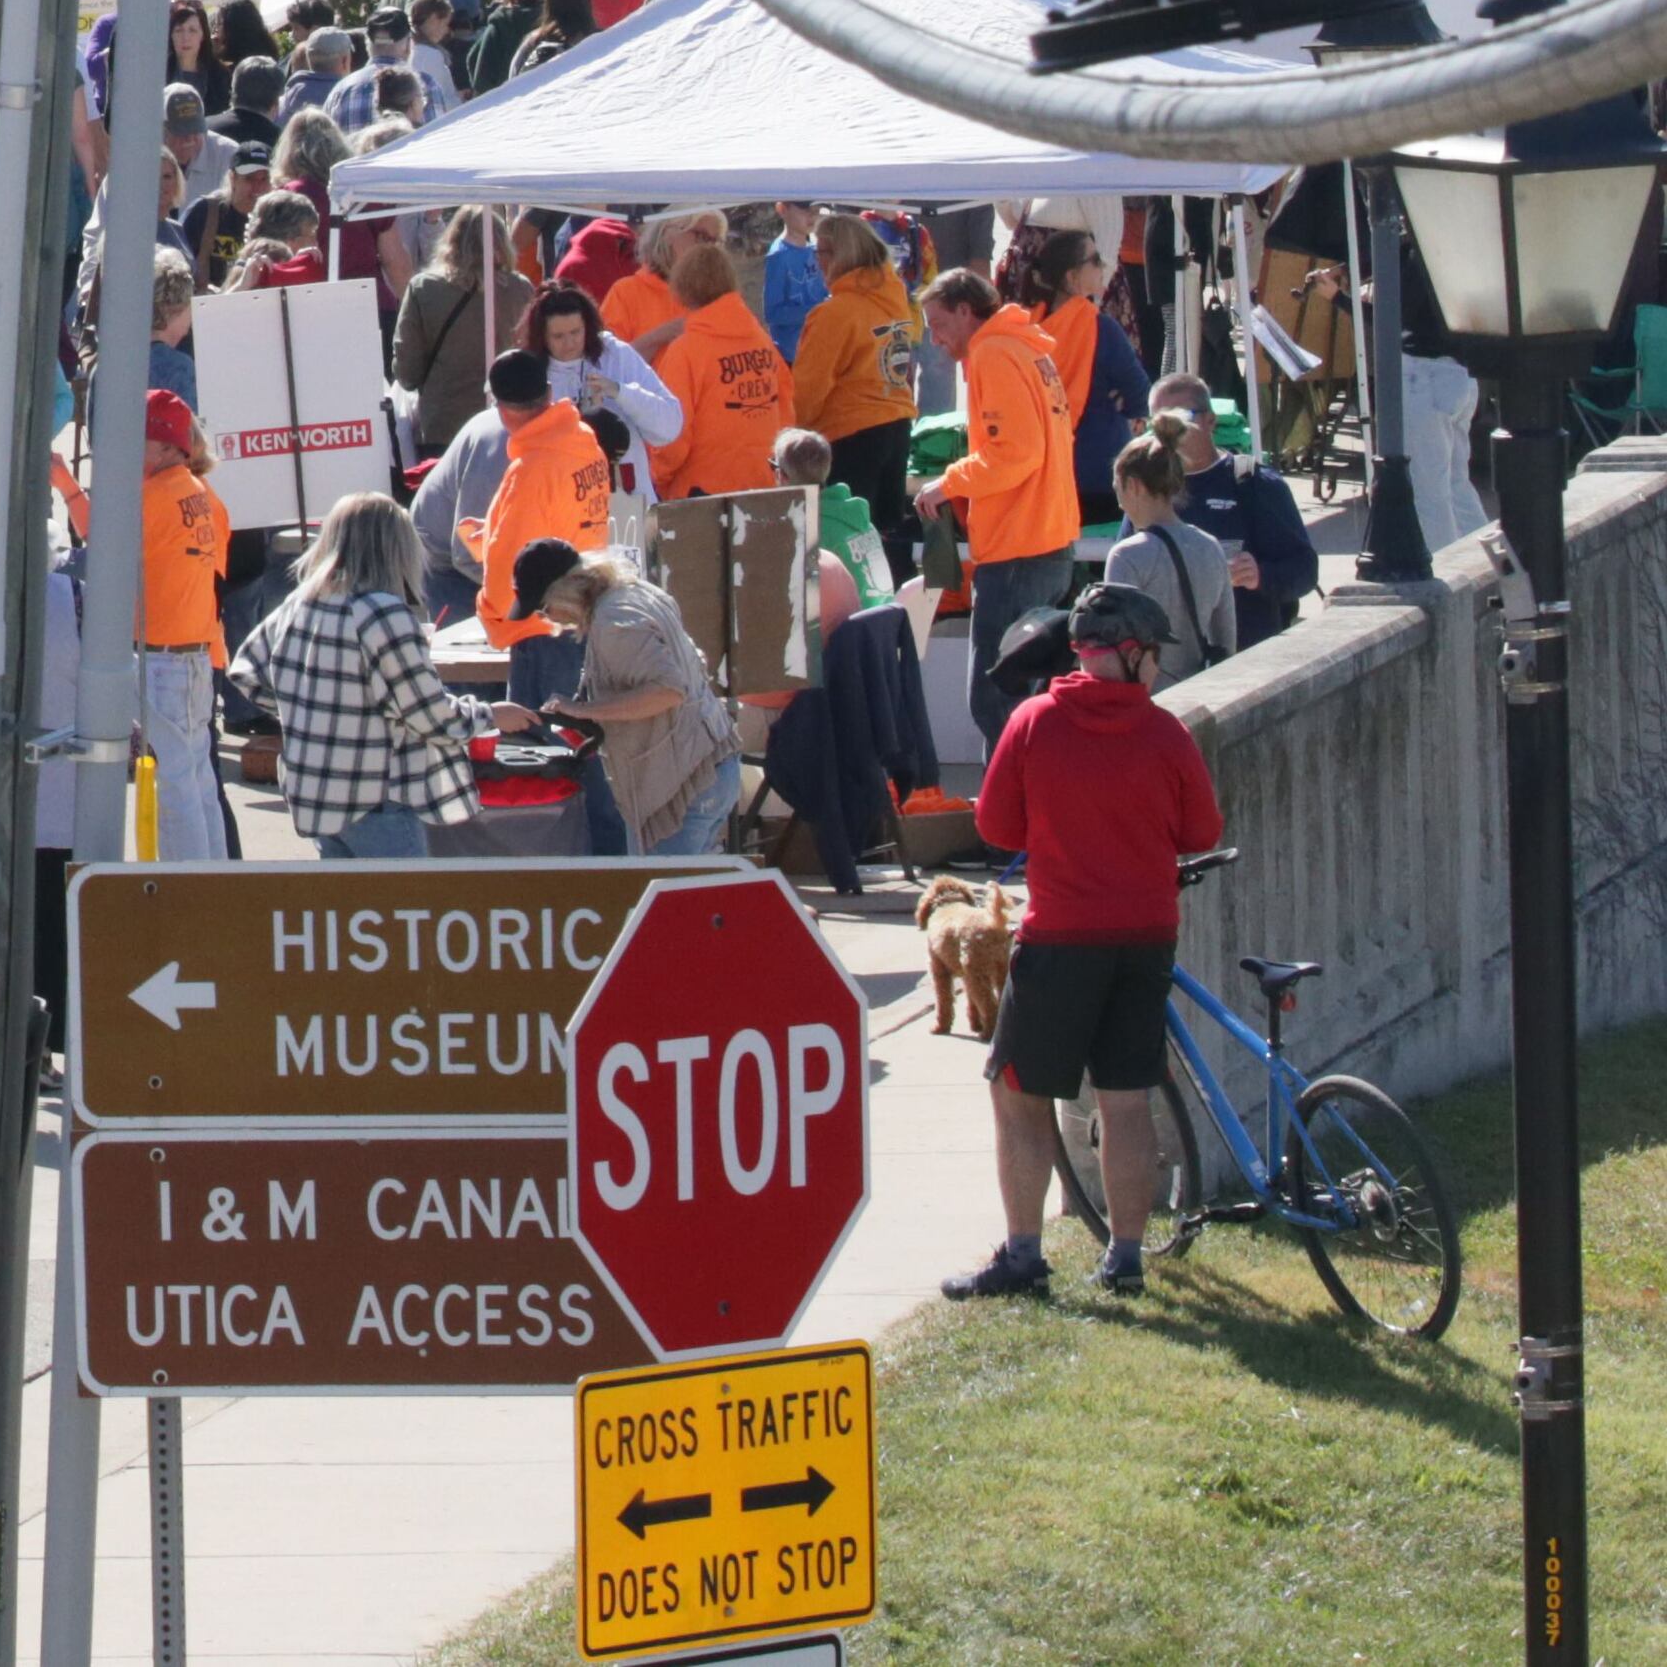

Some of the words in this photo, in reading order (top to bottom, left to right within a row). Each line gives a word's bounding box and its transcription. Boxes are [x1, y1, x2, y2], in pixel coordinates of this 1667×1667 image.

[718, 347, 777, 385] BURGO
[272, 908, 633, 973] HISTORIC
[593, 1022, 845, 1212] STOP
[159, 1180, 172, 1242] I
[201, 1187, 247, 1242] &
[269, 1179, 318, 1241] M
[125, 1285, 307, 1347] UTICA
[347, 1283, 595, 1347] ACCESS
[593, 1407, 699, 1470] CROSS
[717, 1385, 854, 1454] TRAFFIC
[597, 1563, 681, 1623] DOES
[699, 1550, 760, 1606] NOT
[776, 1536, 858, 1598] STOP
